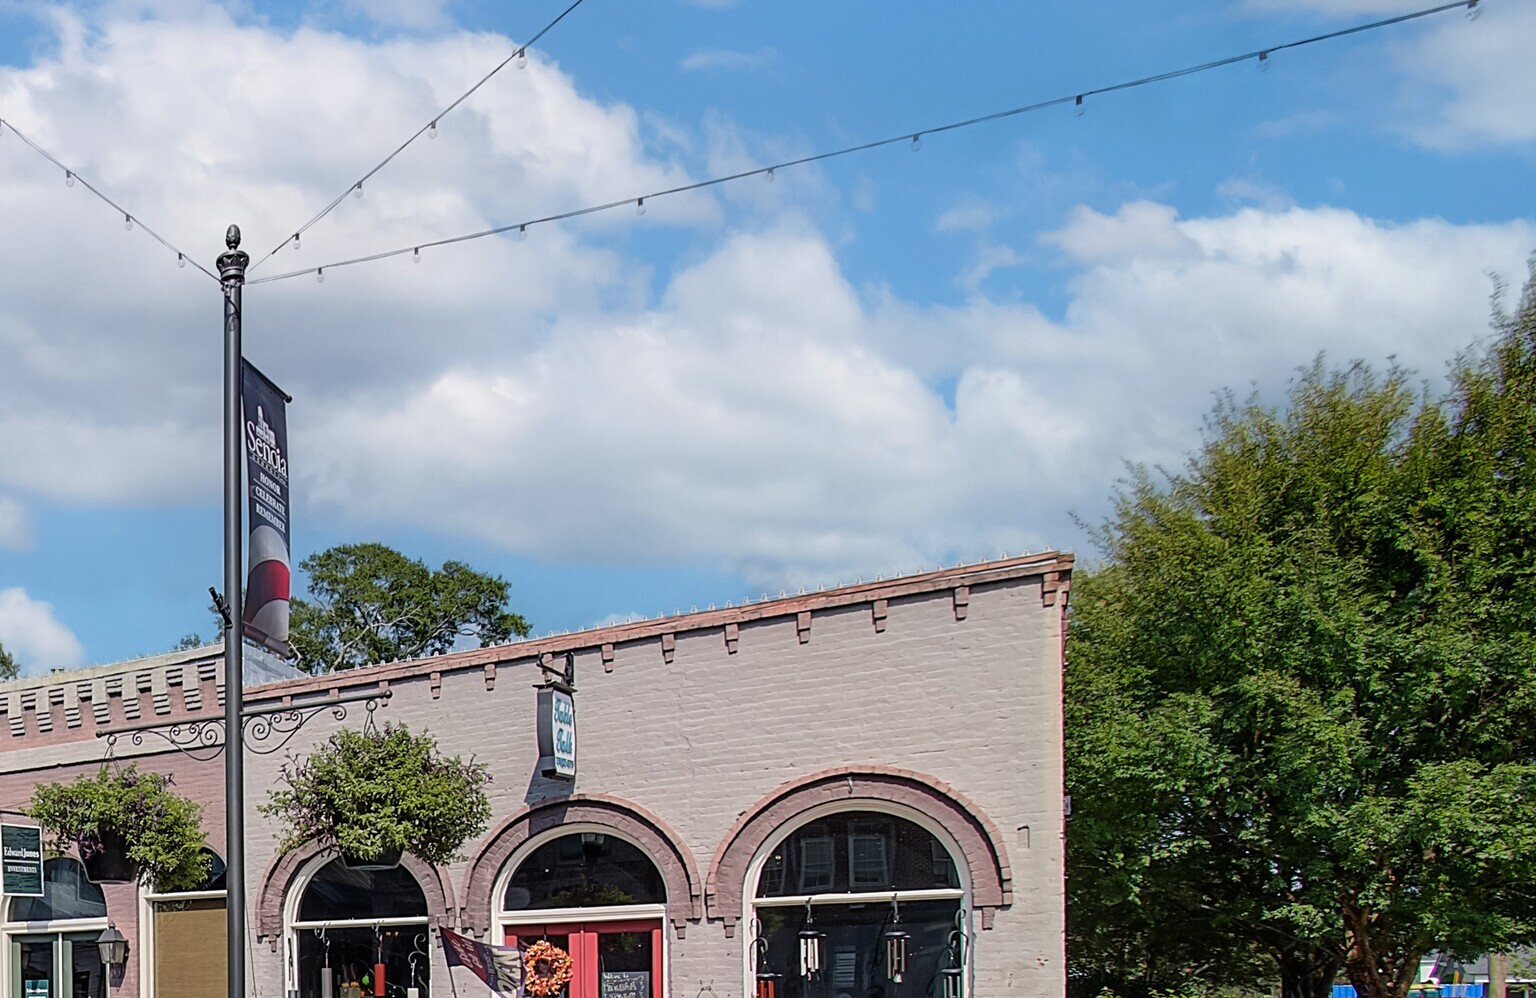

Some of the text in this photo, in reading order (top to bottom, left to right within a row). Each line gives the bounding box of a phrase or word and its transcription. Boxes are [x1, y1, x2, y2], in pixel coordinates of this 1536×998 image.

[247, 421, 287, 478] Senoia
[260, 472, 281, 496] HONOR
[255, 486, 285, 516] CELEBRATE
[256, 504, 285, 533] REMEMBER
